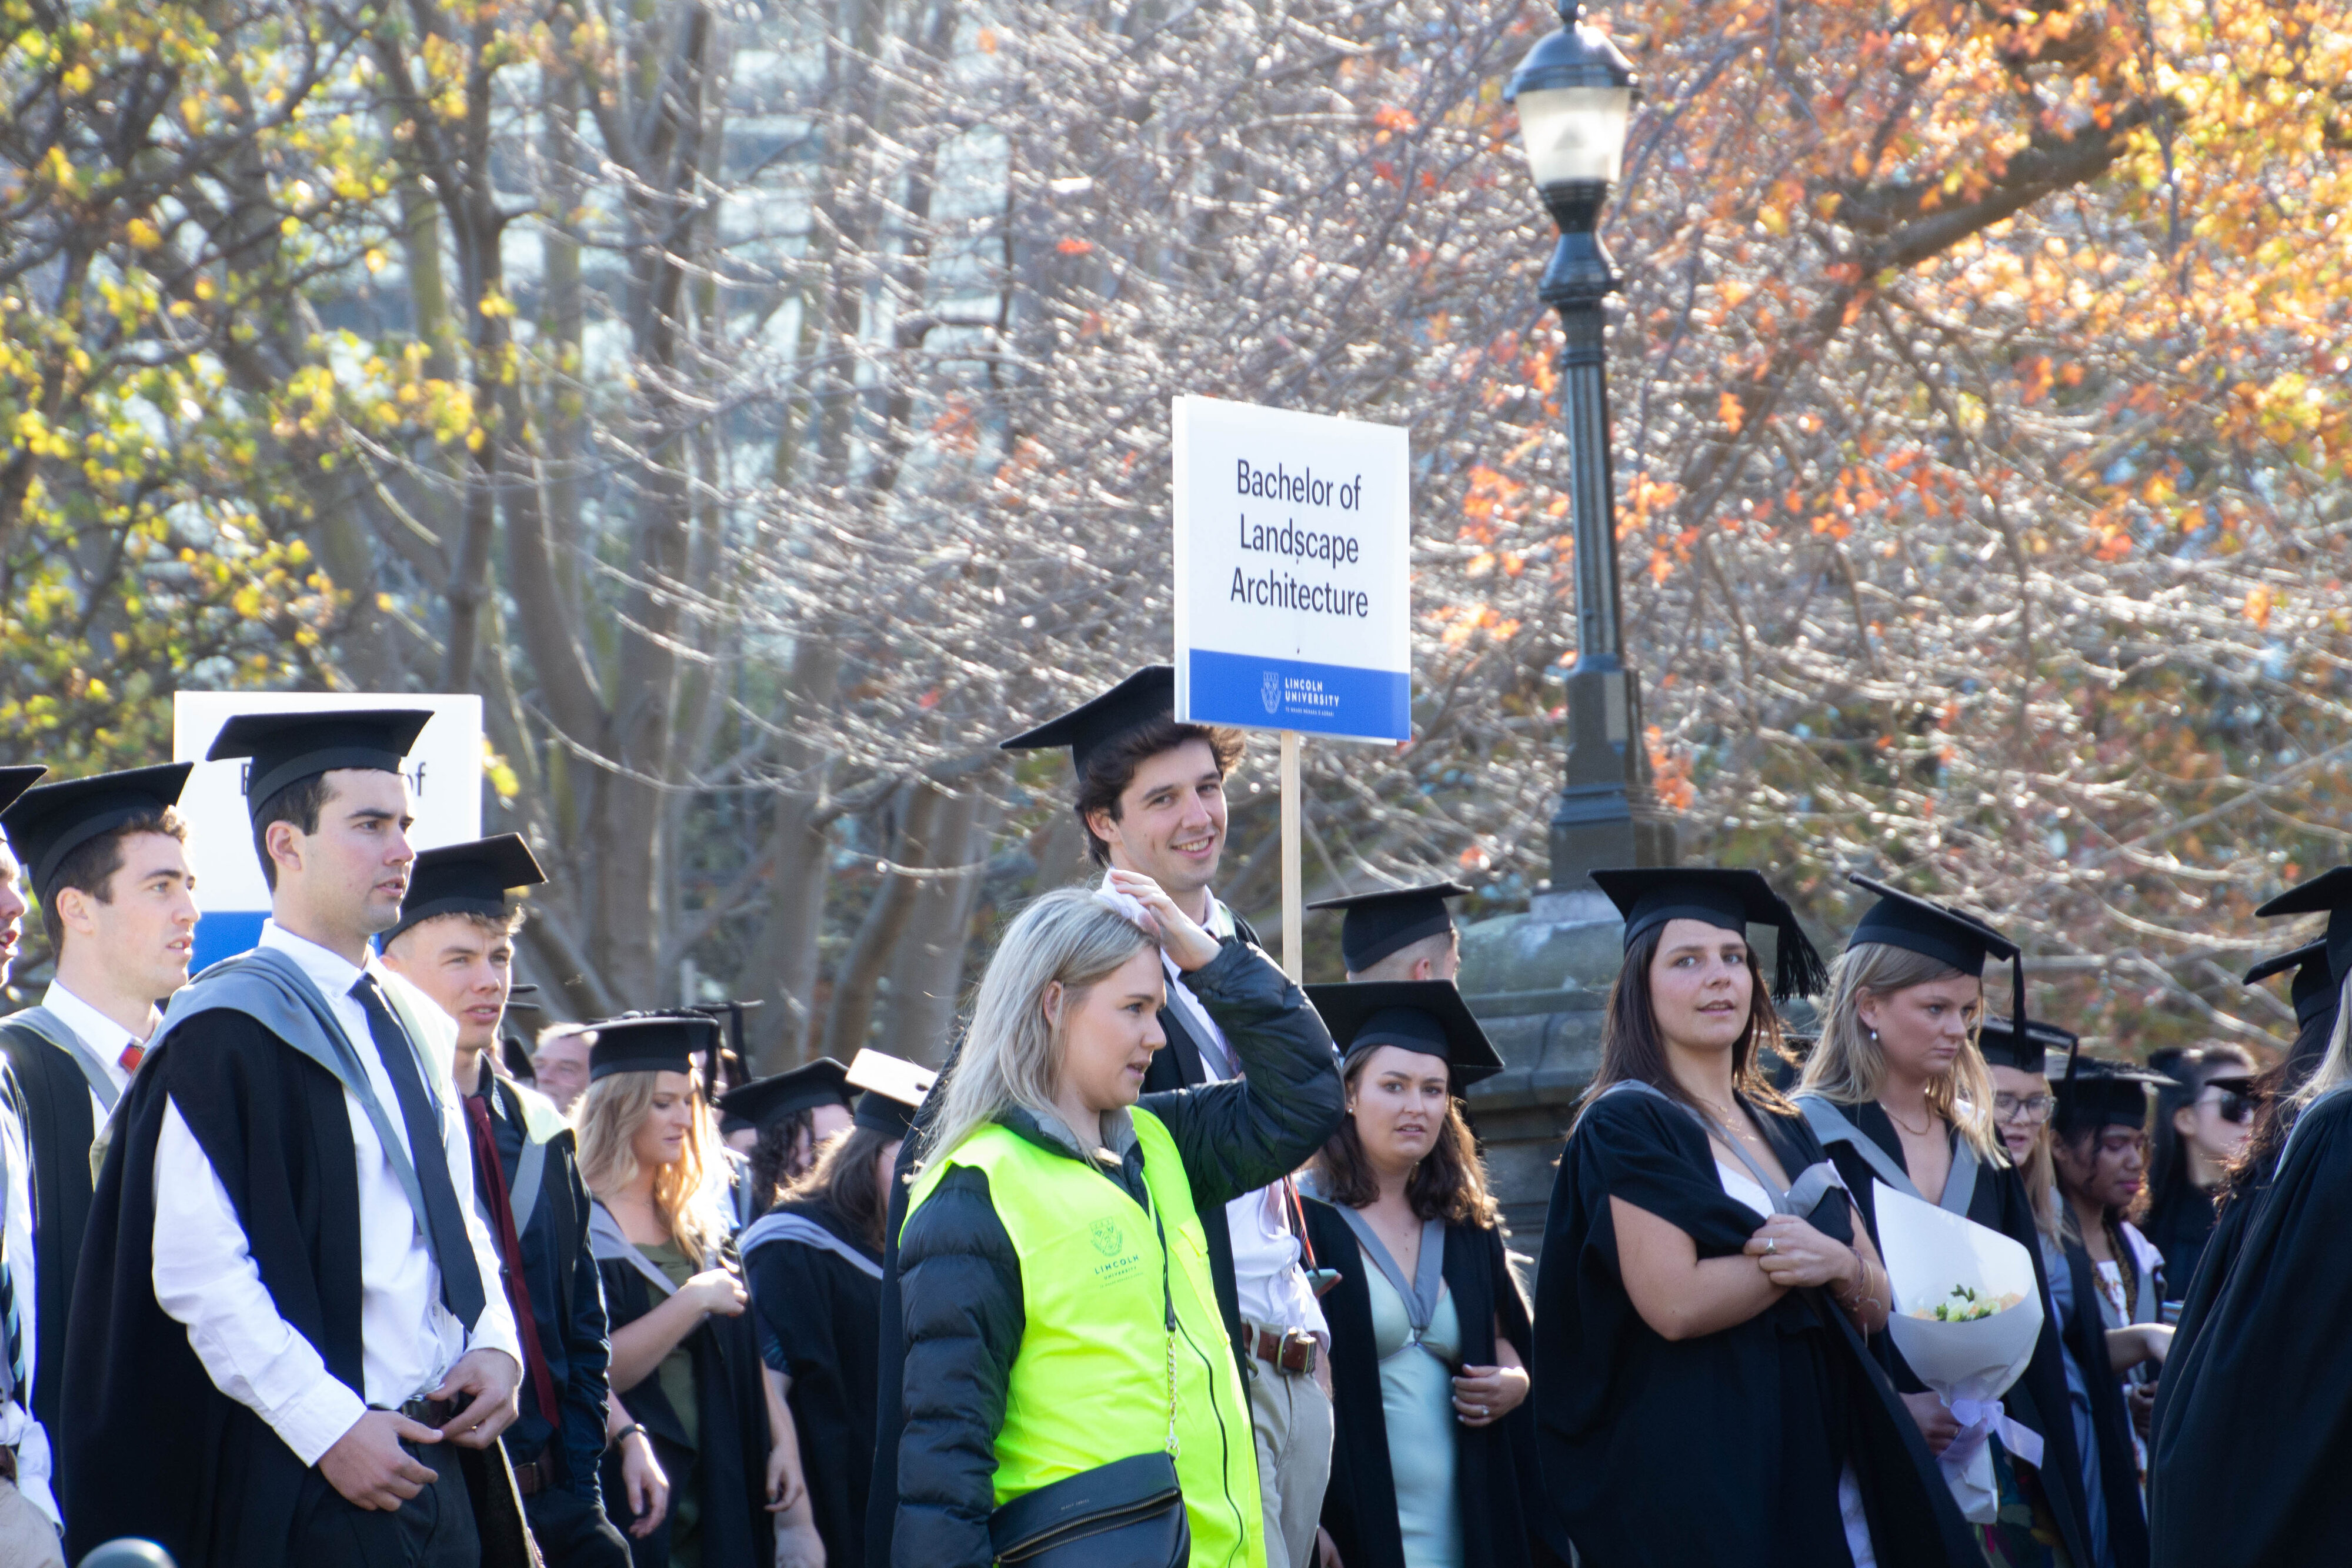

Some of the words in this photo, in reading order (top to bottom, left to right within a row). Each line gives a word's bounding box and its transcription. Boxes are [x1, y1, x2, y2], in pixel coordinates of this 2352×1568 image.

[1237, 458, 1334, 507] Bachelor
[1339, 473, 1362, 511] of
[1240, 513, 1359, 569] Landscape
[1230, 566, 1369, 618] Architecture
[1285, 677, 1323, 692] LINCOLN
[1285, 690, 1339, 707] UNIVERSITY
[406, 762, 426, 796] f
[1095, 1254, 1139, 1275] LINCOLN
